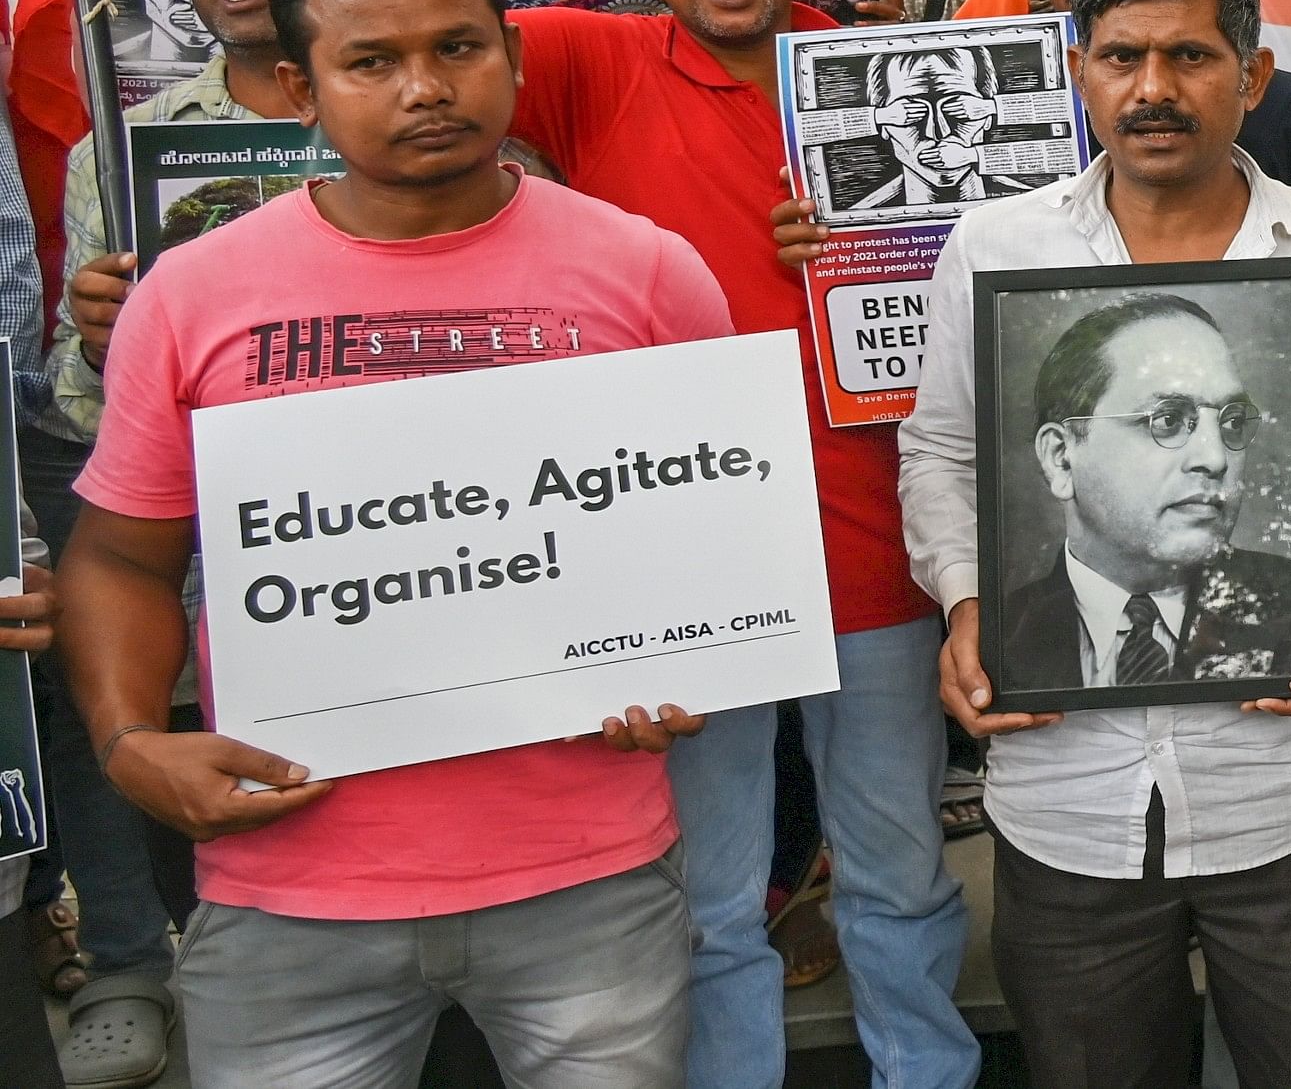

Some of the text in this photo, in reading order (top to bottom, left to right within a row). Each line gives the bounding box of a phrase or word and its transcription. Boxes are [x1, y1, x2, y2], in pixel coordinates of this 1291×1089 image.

[122, 79, 147, 88] 2021
[251, 314, 581, 385] THE STREET
[864, 356, 906, 379] TO
[857, 395, 882, 403] Save
[239, 442, 771, 549] Educate, Agitate,
[243, 531, 561, 626] Organise!
[564, 609, 796, 659] AICCTU AISA CPIML
